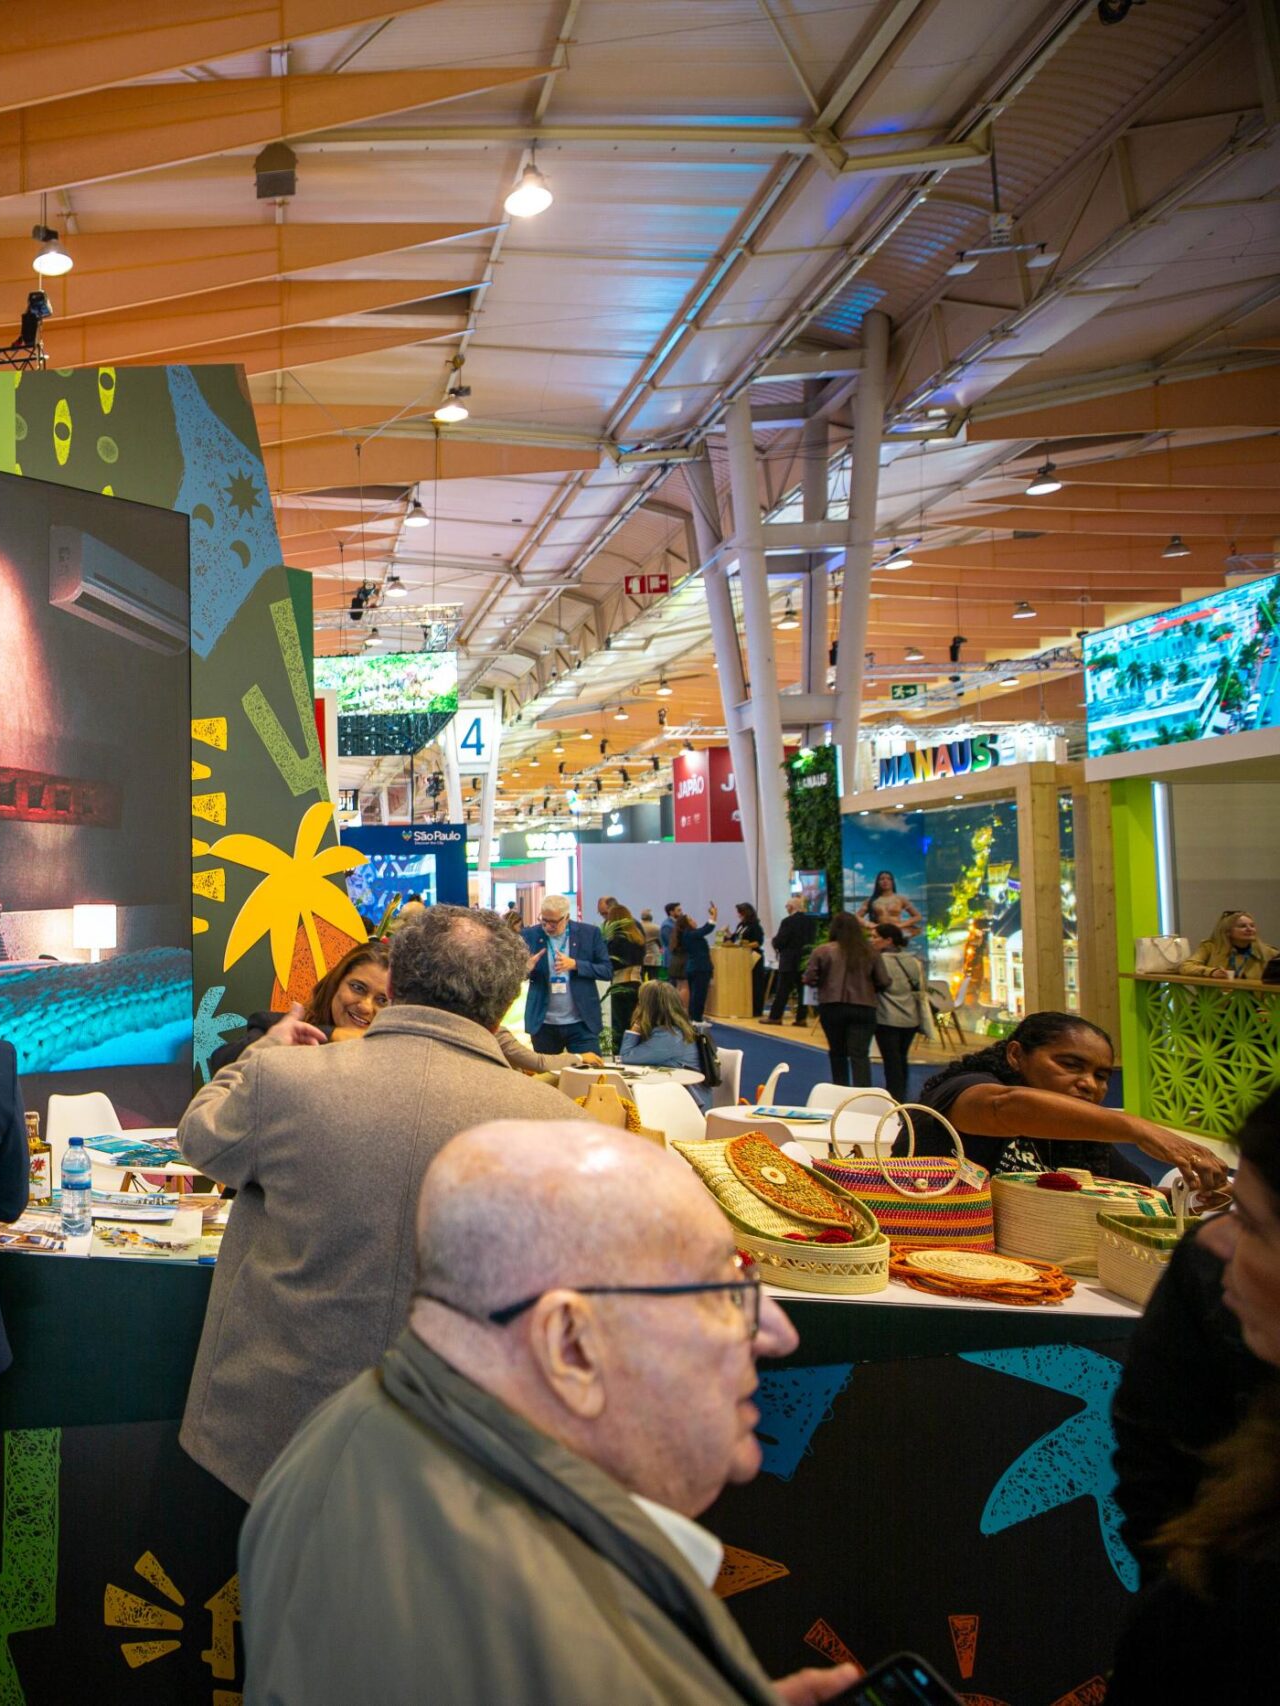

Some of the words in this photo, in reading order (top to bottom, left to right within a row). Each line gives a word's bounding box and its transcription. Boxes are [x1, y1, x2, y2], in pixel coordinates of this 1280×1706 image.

[460, 717, 485, 756] 4
[878, 734, 994, 791] MANAUS
[677, 773, 705, 799] JAPÃO
[413, 830, 433, 841] São
[434, 830, 461, 841] Paulo
